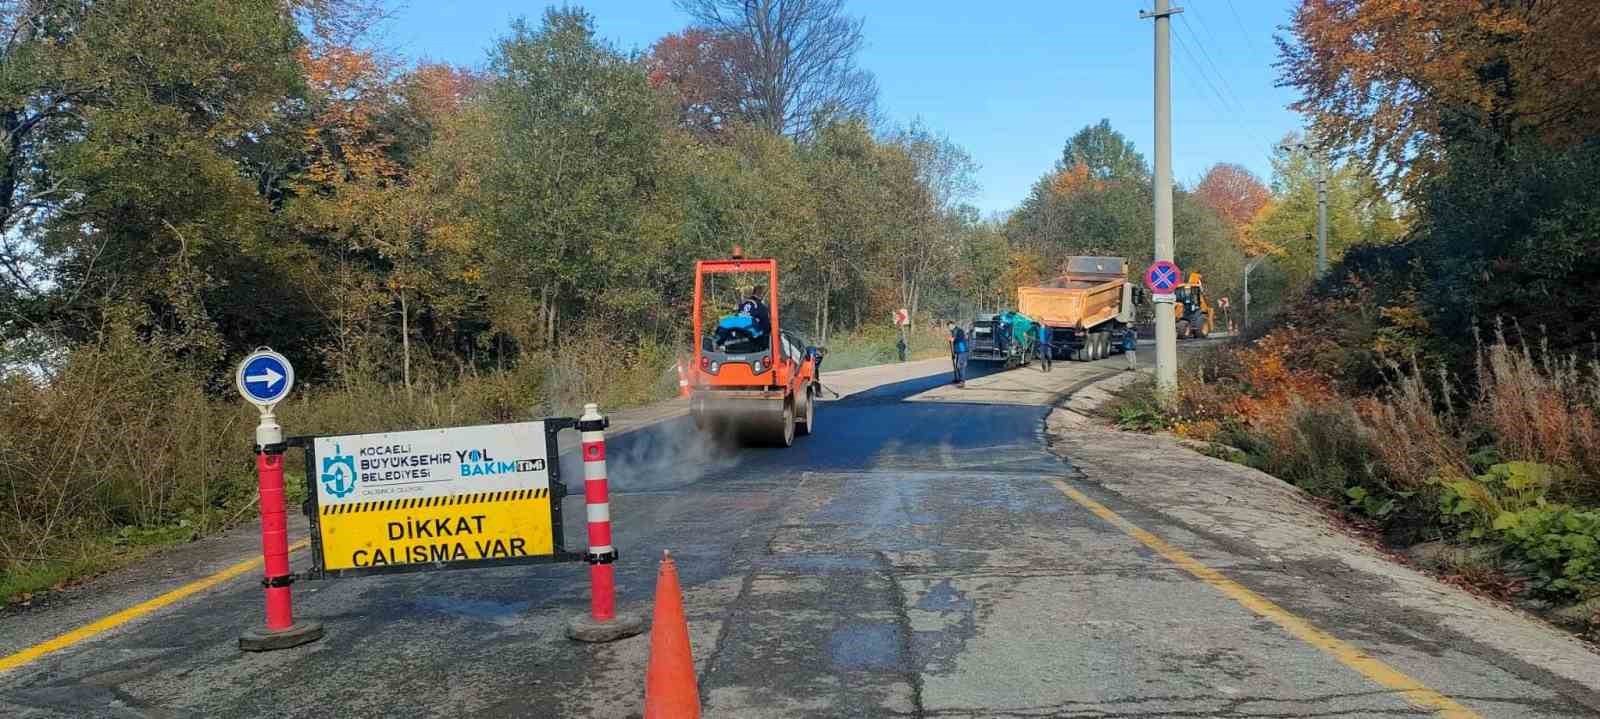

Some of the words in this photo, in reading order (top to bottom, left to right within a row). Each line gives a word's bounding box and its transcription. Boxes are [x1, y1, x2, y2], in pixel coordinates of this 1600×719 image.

[360, 444, 411, 456] KOCAELİ
[456, 448, 493, 463] YOL
[361, 453, 451, 470] BÜYÜKŞEHİR
[461, 462, 515, 476] BAKIM
[362, 469, 431, 482] BELEDİYESİ
[388, 515, 486, 541] DİKKAT
[475, 538, 527, 559] VAR
